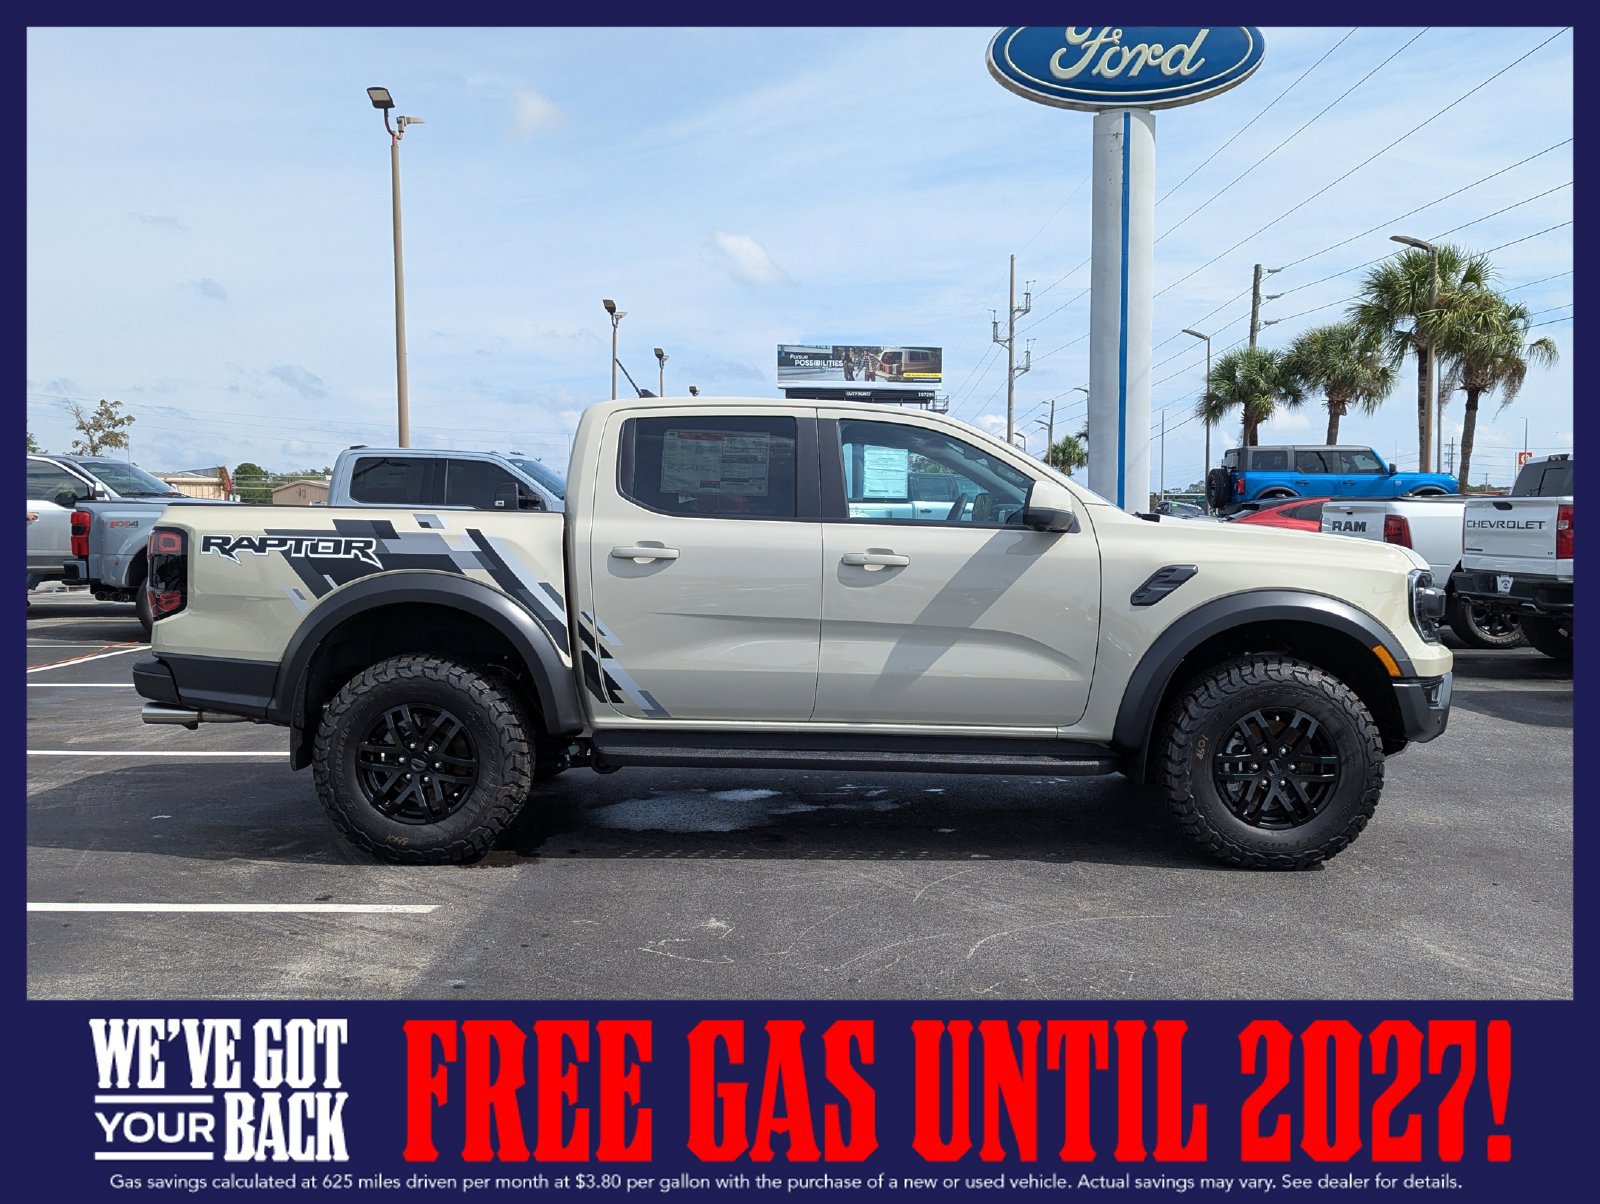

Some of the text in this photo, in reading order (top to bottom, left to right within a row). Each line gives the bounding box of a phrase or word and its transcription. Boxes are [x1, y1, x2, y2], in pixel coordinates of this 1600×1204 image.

[1049, 26, 1210, 80] Ford
[794, 359, 844, 367] POSSIBILITIES
[1331, 520, 1367, 532] RAM
[1466, 520, 1546, 530] CHEVROLET
[201, 534, 384, 570] RAPTOR
